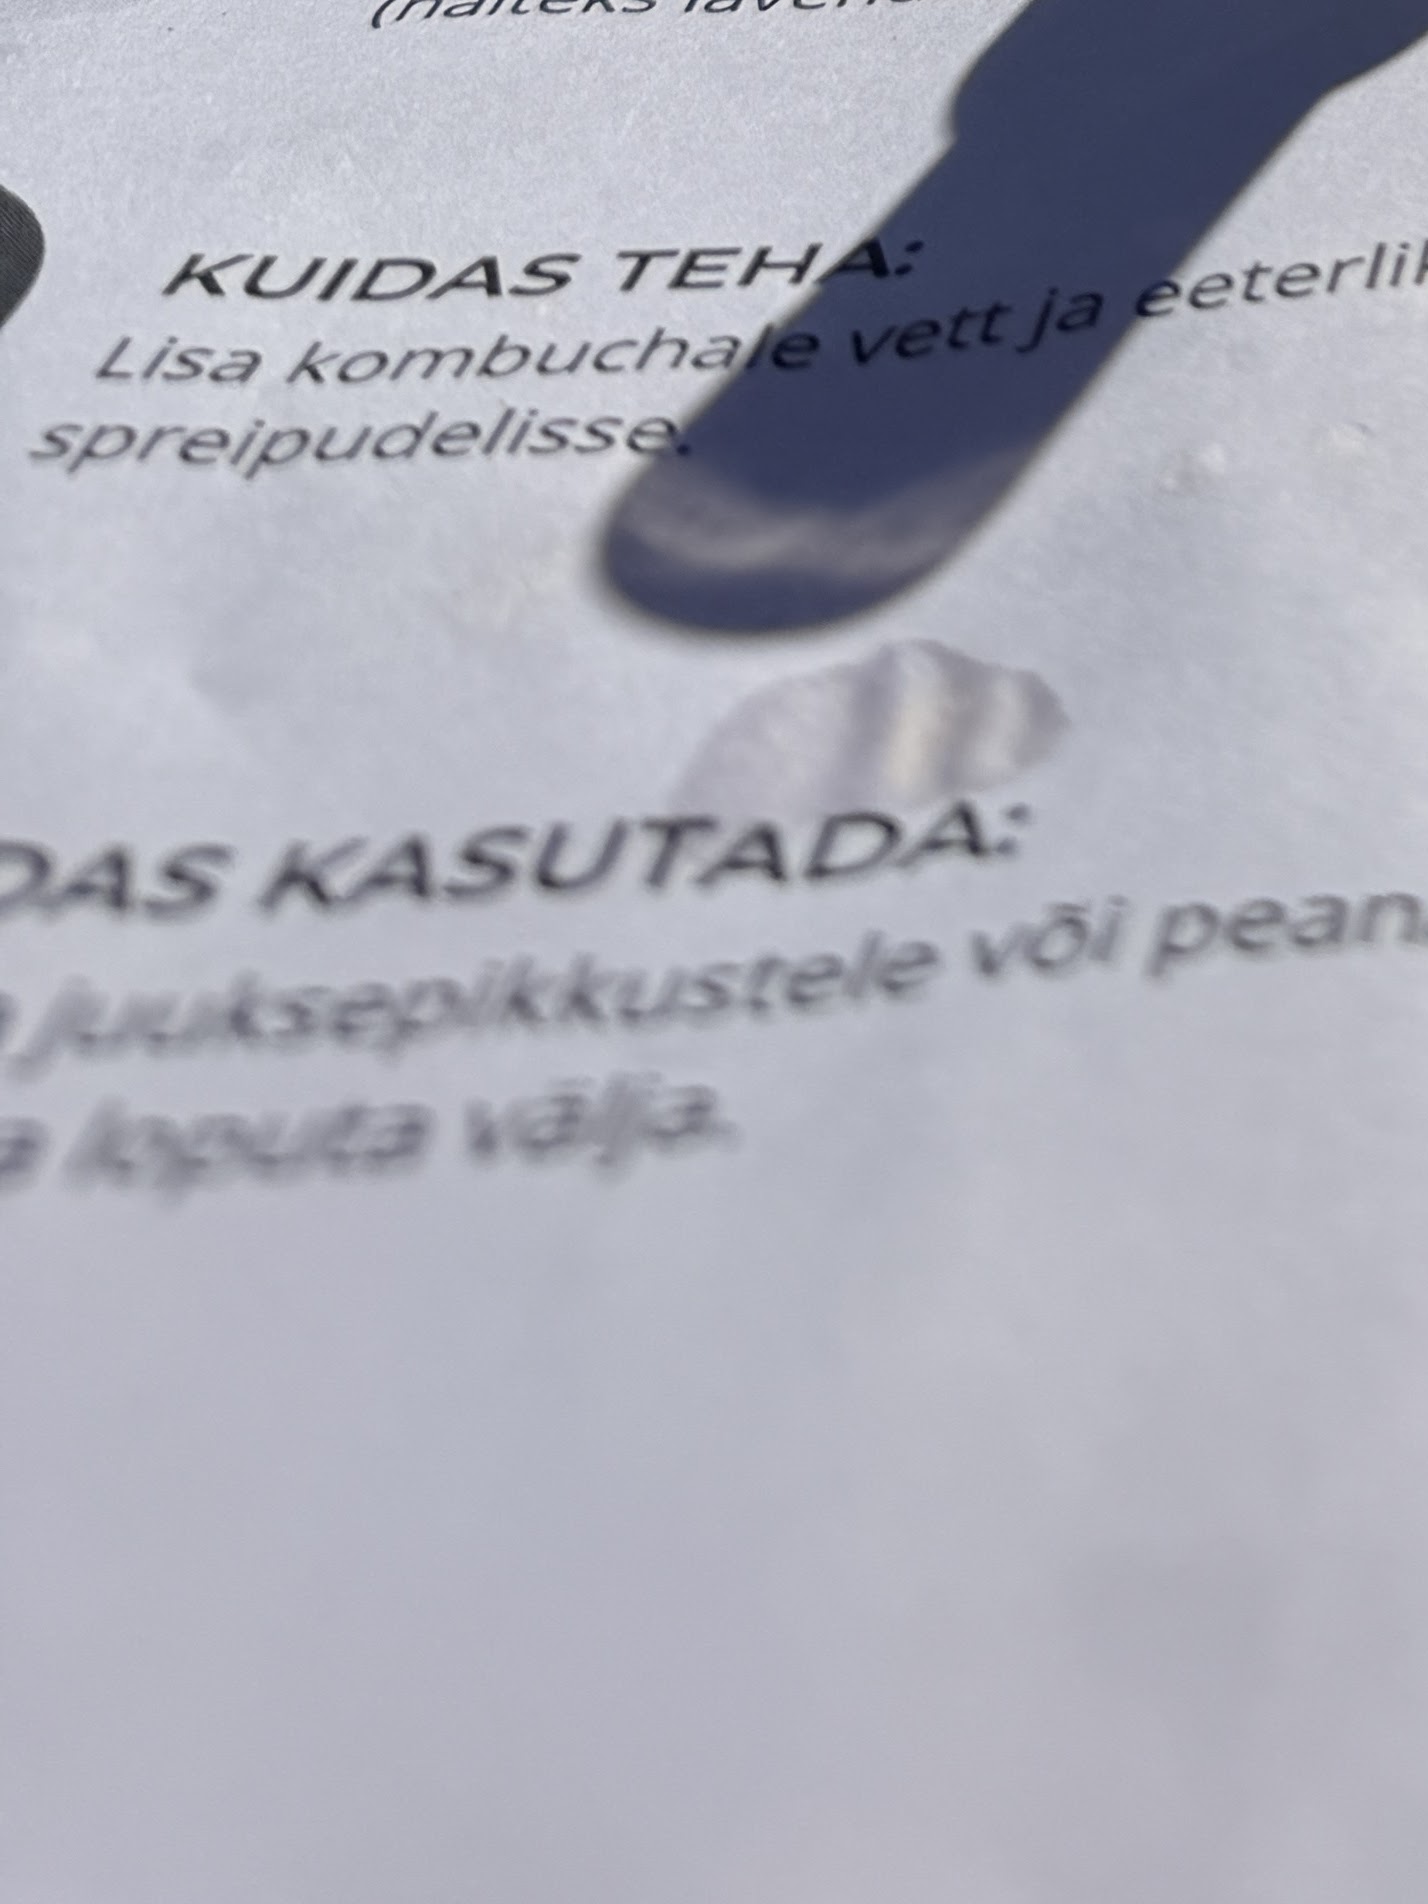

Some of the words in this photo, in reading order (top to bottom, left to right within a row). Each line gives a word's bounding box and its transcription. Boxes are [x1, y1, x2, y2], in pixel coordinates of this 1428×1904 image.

[161, 251, 583, 303] KUIDAS
[615, 237, 925, 292] TEHA:
[94, 334, 265, 386] Lisa
[285, 322, 822, 389] kombuchale
[850, 302, 1011, 368] vett
[1014, 284, 1105, 355] ja
[28, 406, 694, 479] spreipudelisse.
[256, 799, 1035, 914] KASUTADA:
[8, 930, 942, 1081] juuksepikkustele
[968, 894, 1136, 982] või
